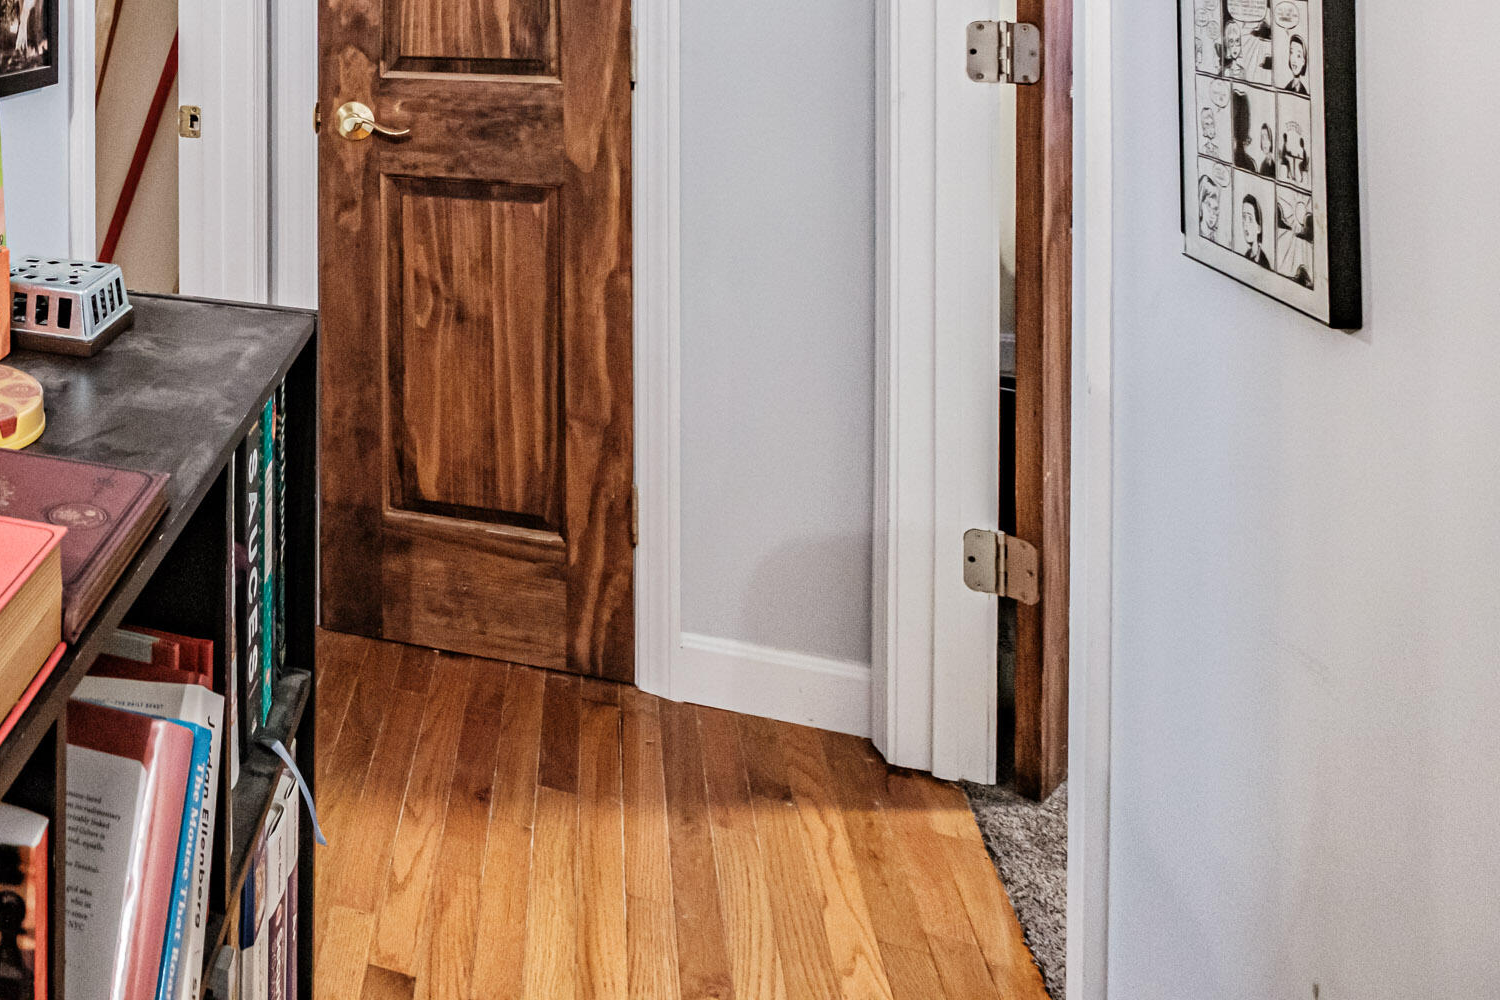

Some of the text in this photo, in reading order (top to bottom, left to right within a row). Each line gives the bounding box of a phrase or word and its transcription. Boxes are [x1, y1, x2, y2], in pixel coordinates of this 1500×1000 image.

[248, 448, 258, 683] SAUCES
[192, 763, 205, 802] The
[182, 807, 200, 881] Mouse
[194, 716, 215, 929] Jdan Ellenberg
[173, 885, 189, 940] That
